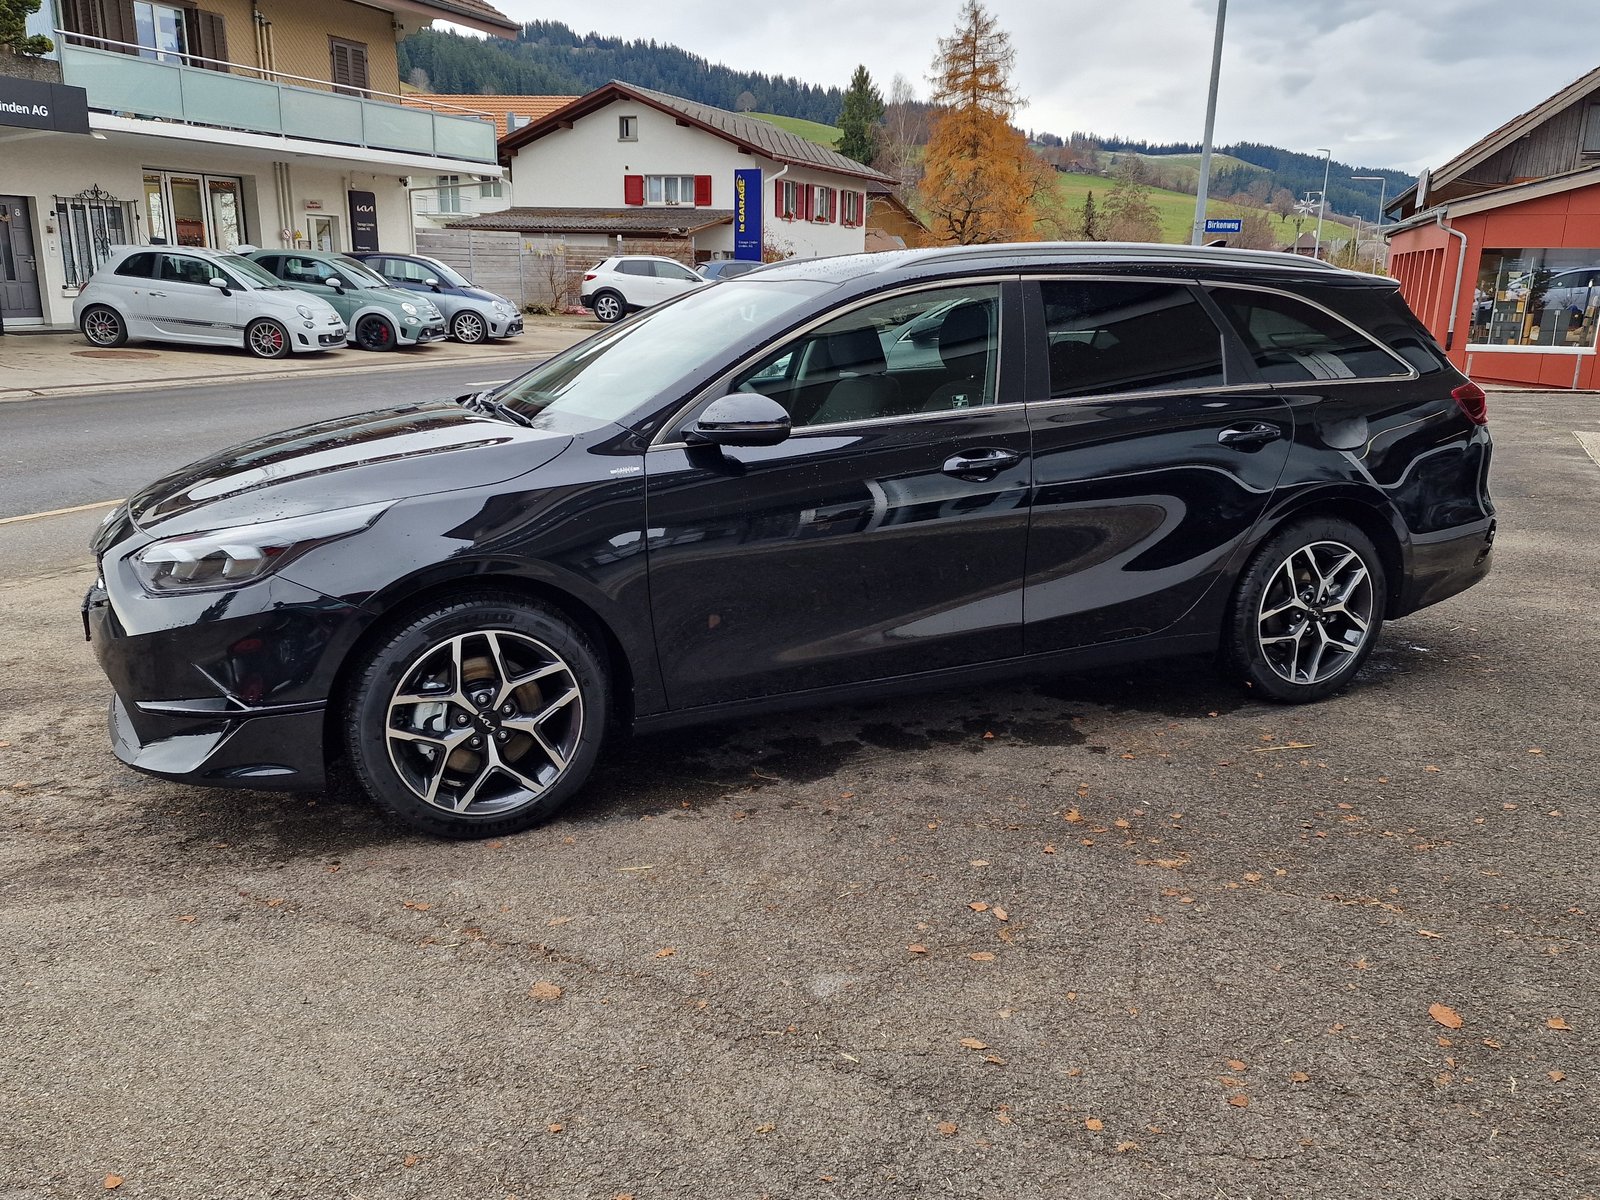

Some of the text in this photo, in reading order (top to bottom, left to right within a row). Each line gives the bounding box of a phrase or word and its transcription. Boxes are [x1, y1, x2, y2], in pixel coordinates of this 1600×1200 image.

[32, 104, 48, 117] AG
[15, 208, 21, 217] 8
[1207, 220, 1239, 231] Birkenweg
